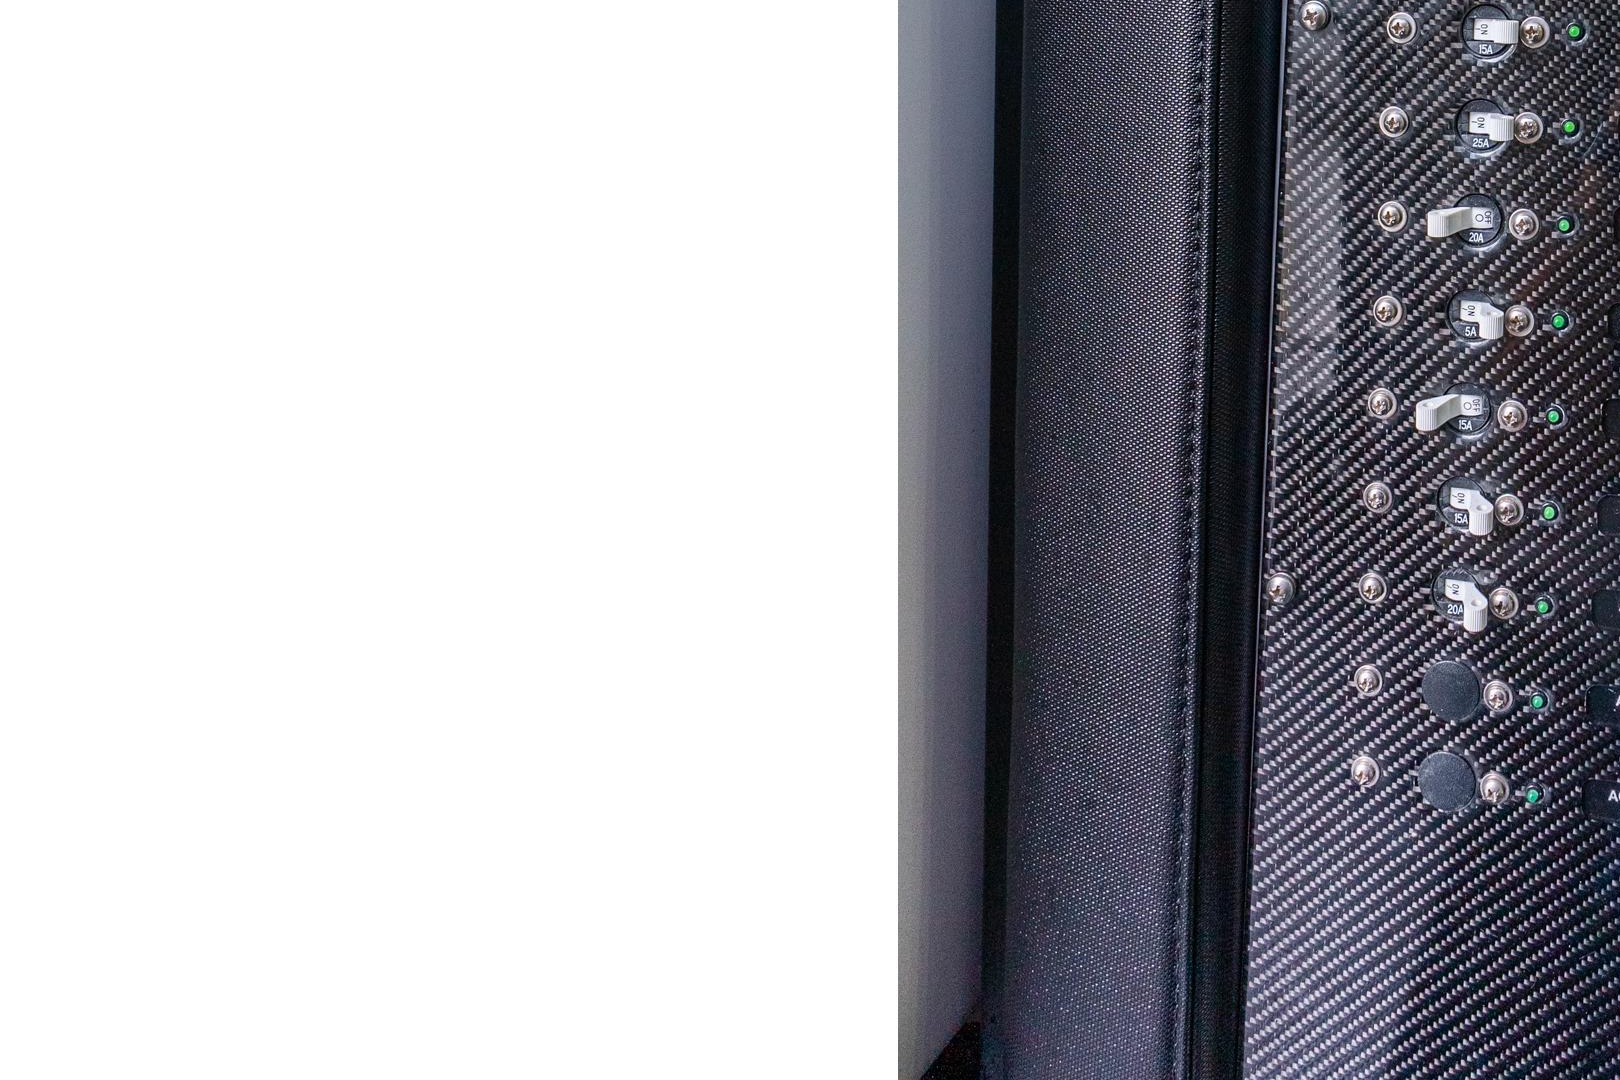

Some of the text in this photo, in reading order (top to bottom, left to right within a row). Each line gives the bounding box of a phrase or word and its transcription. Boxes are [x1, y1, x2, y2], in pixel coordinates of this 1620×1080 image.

[1481, 24, 1488, 35] ON
[1479, 44, 1493, 54] 15A
[1477, 117, 1485, 129] ON
[1472, 138, 1490, 148] 25A
[1469, 232, 1484, 243] 20A
[1468, 305, 1476, 316] ON
[1464, 326, 1477, 337] 5A
[1473, 399, 1481, 412] OFF
[1458, 420, 1472, 431] 15A
[1457, 492, 1465, 504] ON
[1454, 513, 1468, 524] 15A
[1452, 584, 1459, 595] ON
[1447, 604, 1464, 615] 20A
